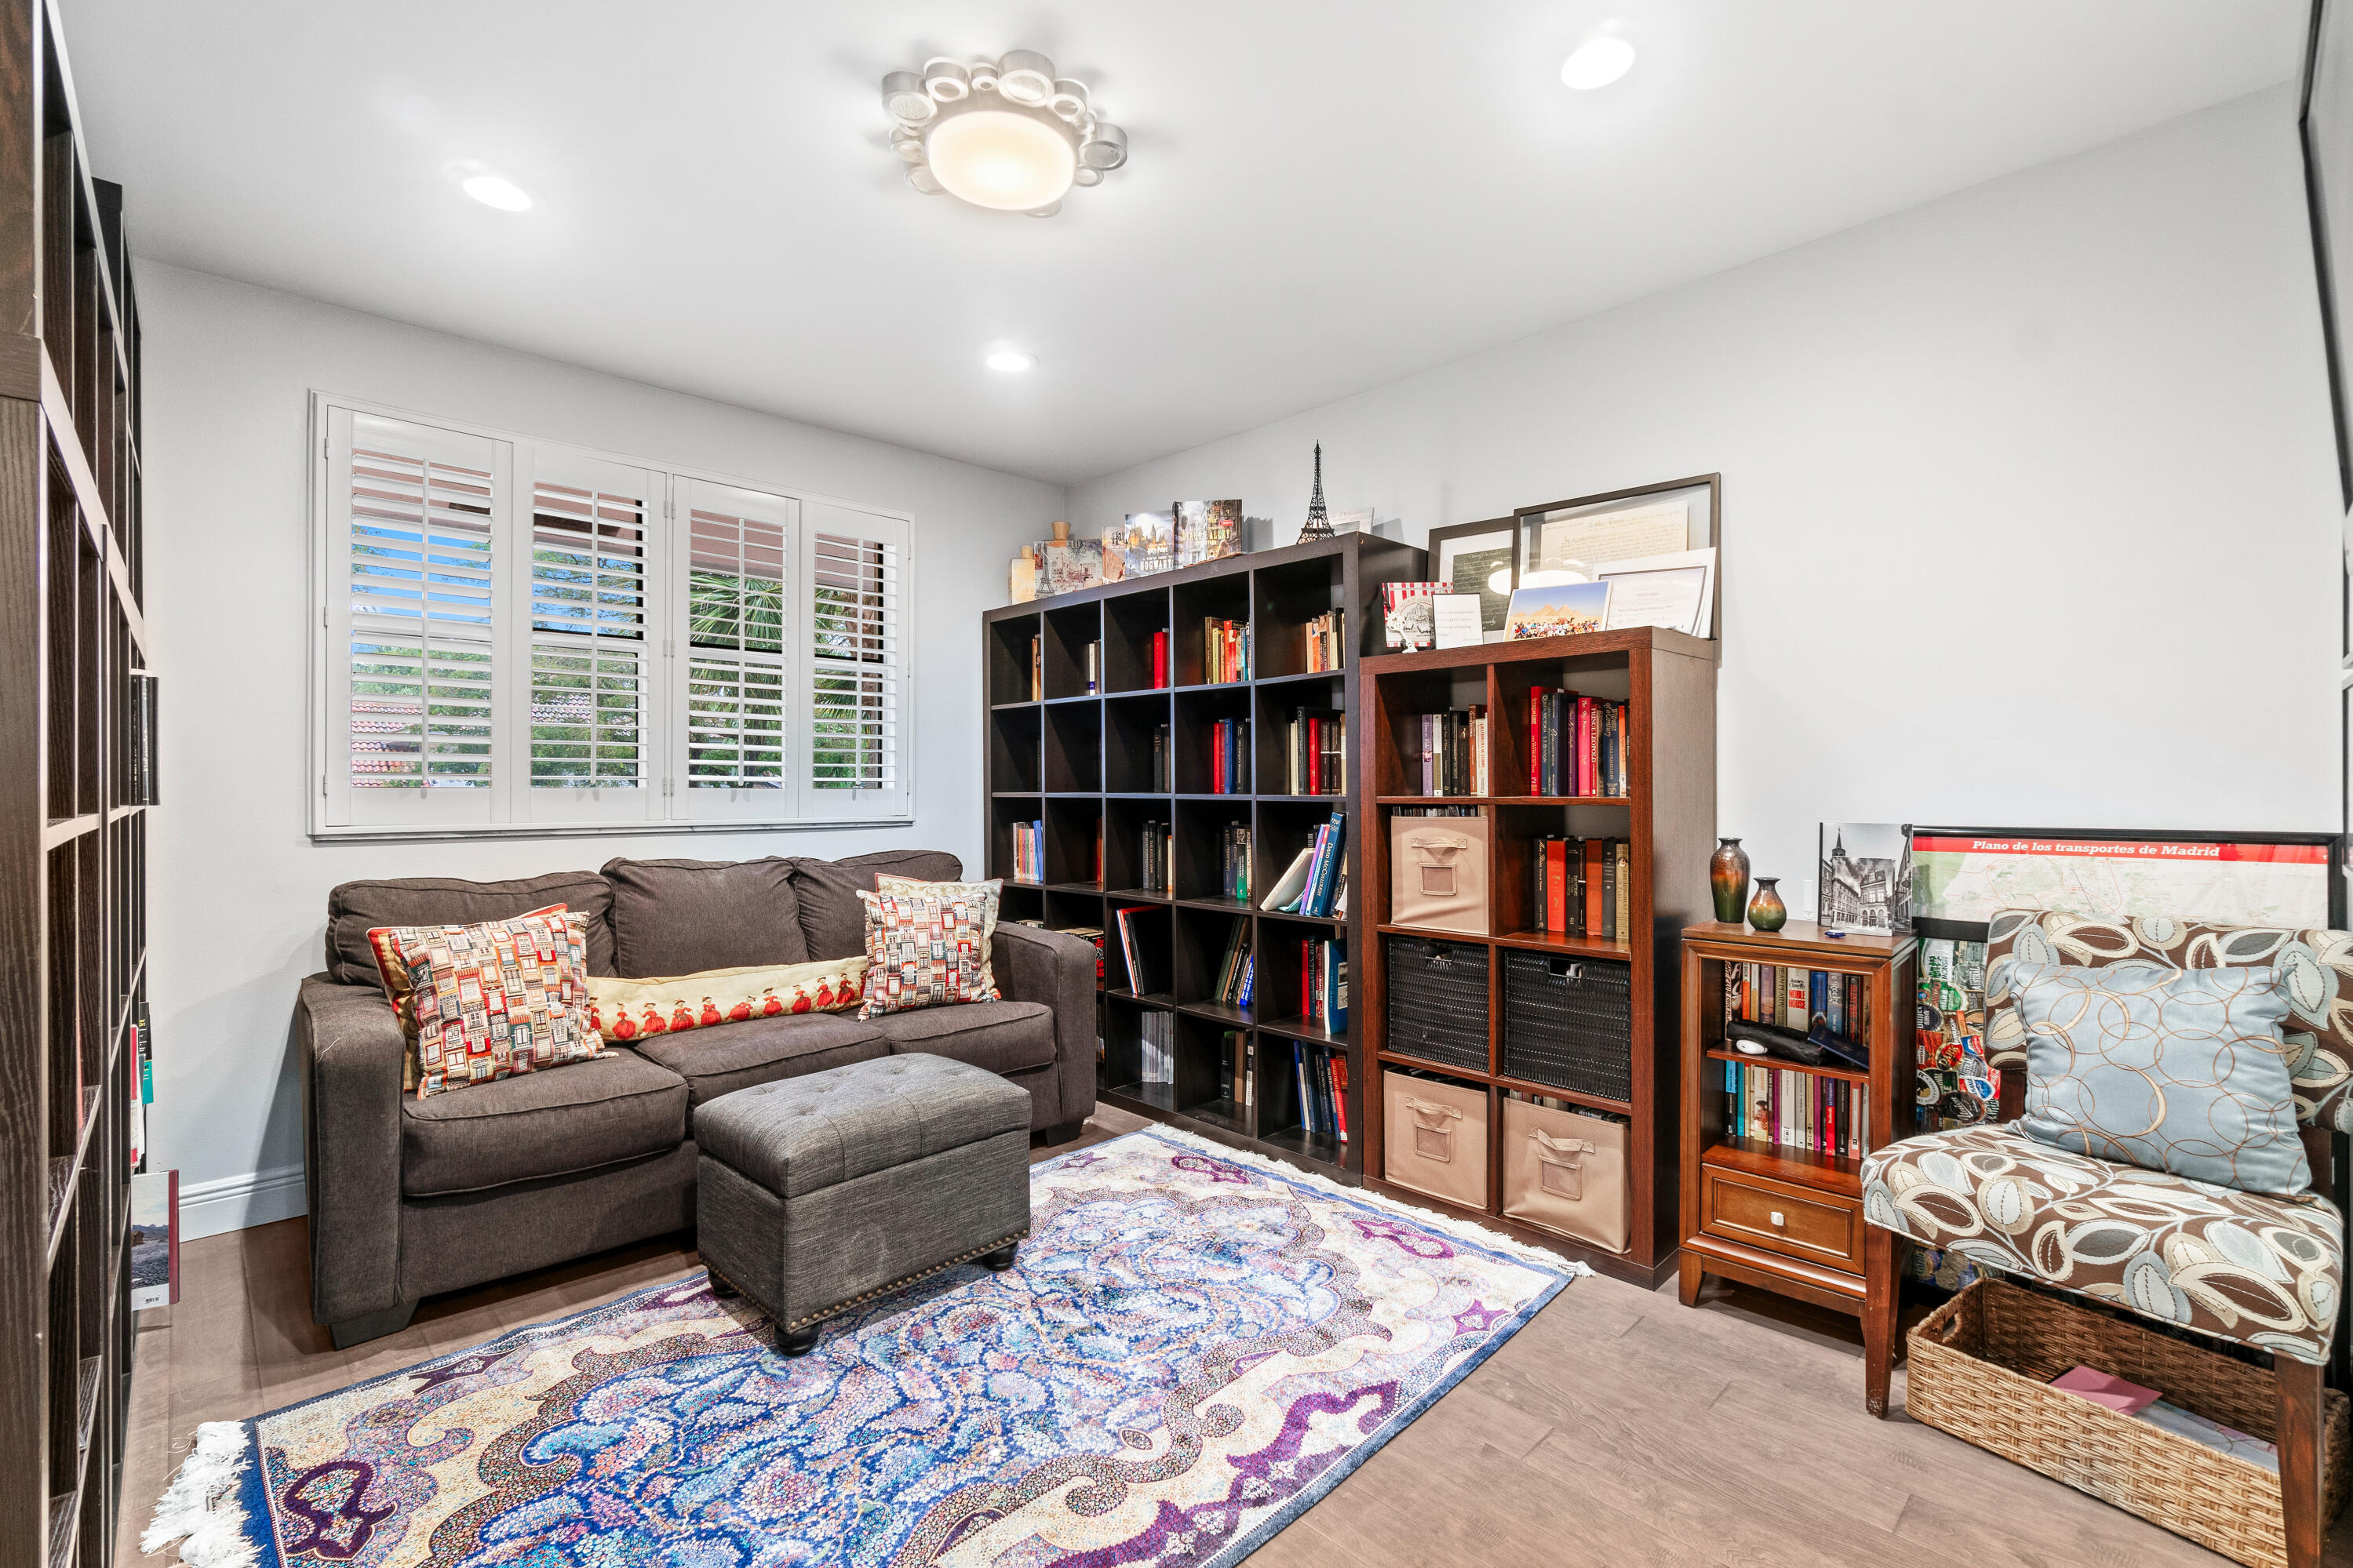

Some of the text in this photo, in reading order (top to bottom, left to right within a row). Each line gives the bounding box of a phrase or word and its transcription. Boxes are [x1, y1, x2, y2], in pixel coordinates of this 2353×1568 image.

[1325, 842, 1334, 860] DAVID
[1972, 839, 2220, 857] Plano de los transportes de Madrid
[1969, 966, 1982, 990] AUSTRAL
[1788, 989, 1806, 999] NOBLE
[1828, 981, 1838, 1005] Rocks
[1788, 999, 1806, 1010] HOUSE
[1938, 1046, 1959, 1066] DARK
